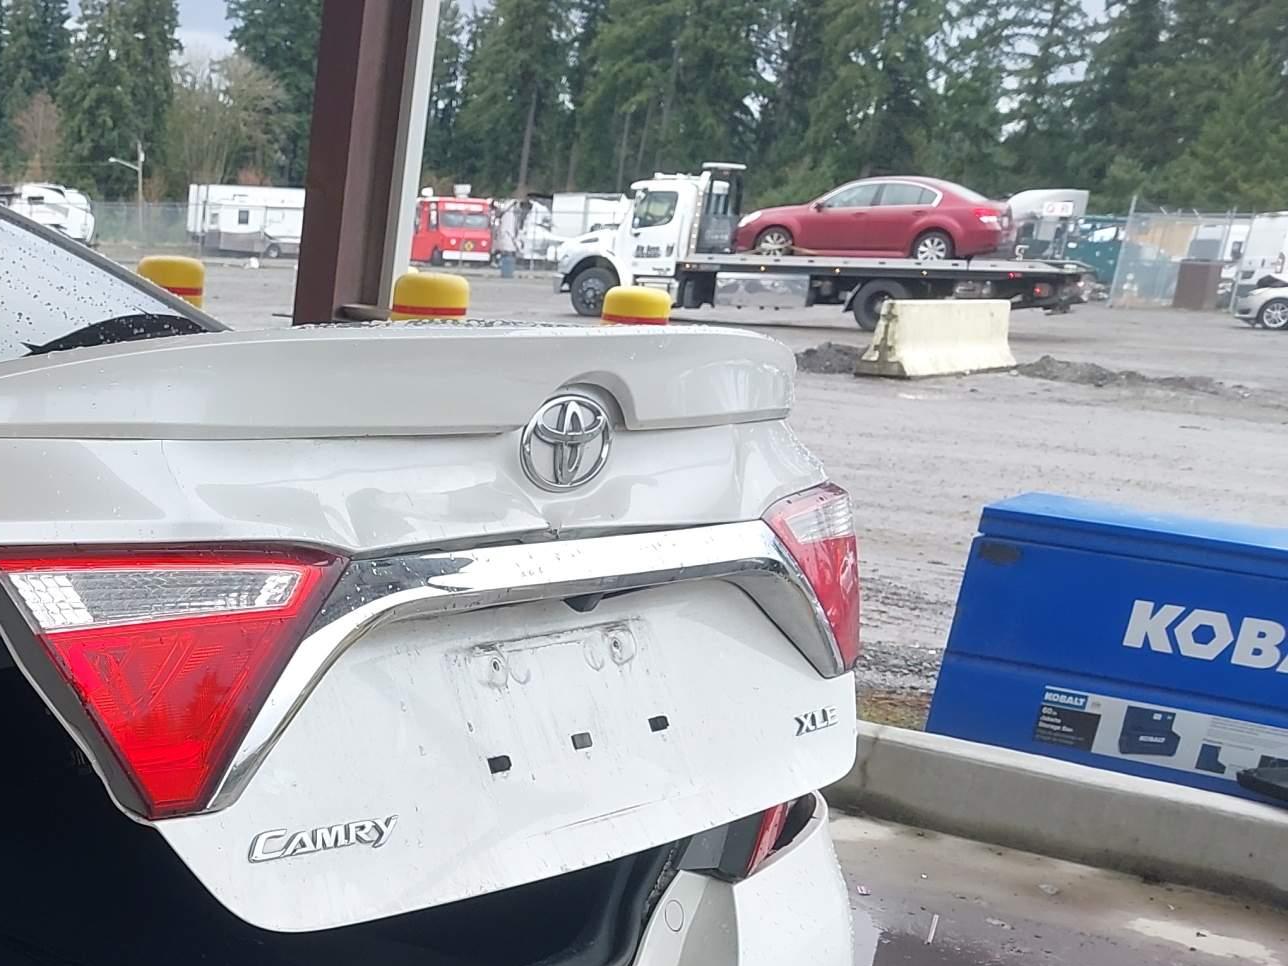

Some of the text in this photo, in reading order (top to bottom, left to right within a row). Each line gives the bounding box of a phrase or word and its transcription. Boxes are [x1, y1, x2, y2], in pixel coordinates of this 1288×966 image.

[1122, 599, 1288, 674] KOB
[1044, 691, 1086, 706] KOBALT
[794, 706, 839, 736] XLE
[248, 814, 399, 863] CAMRY
